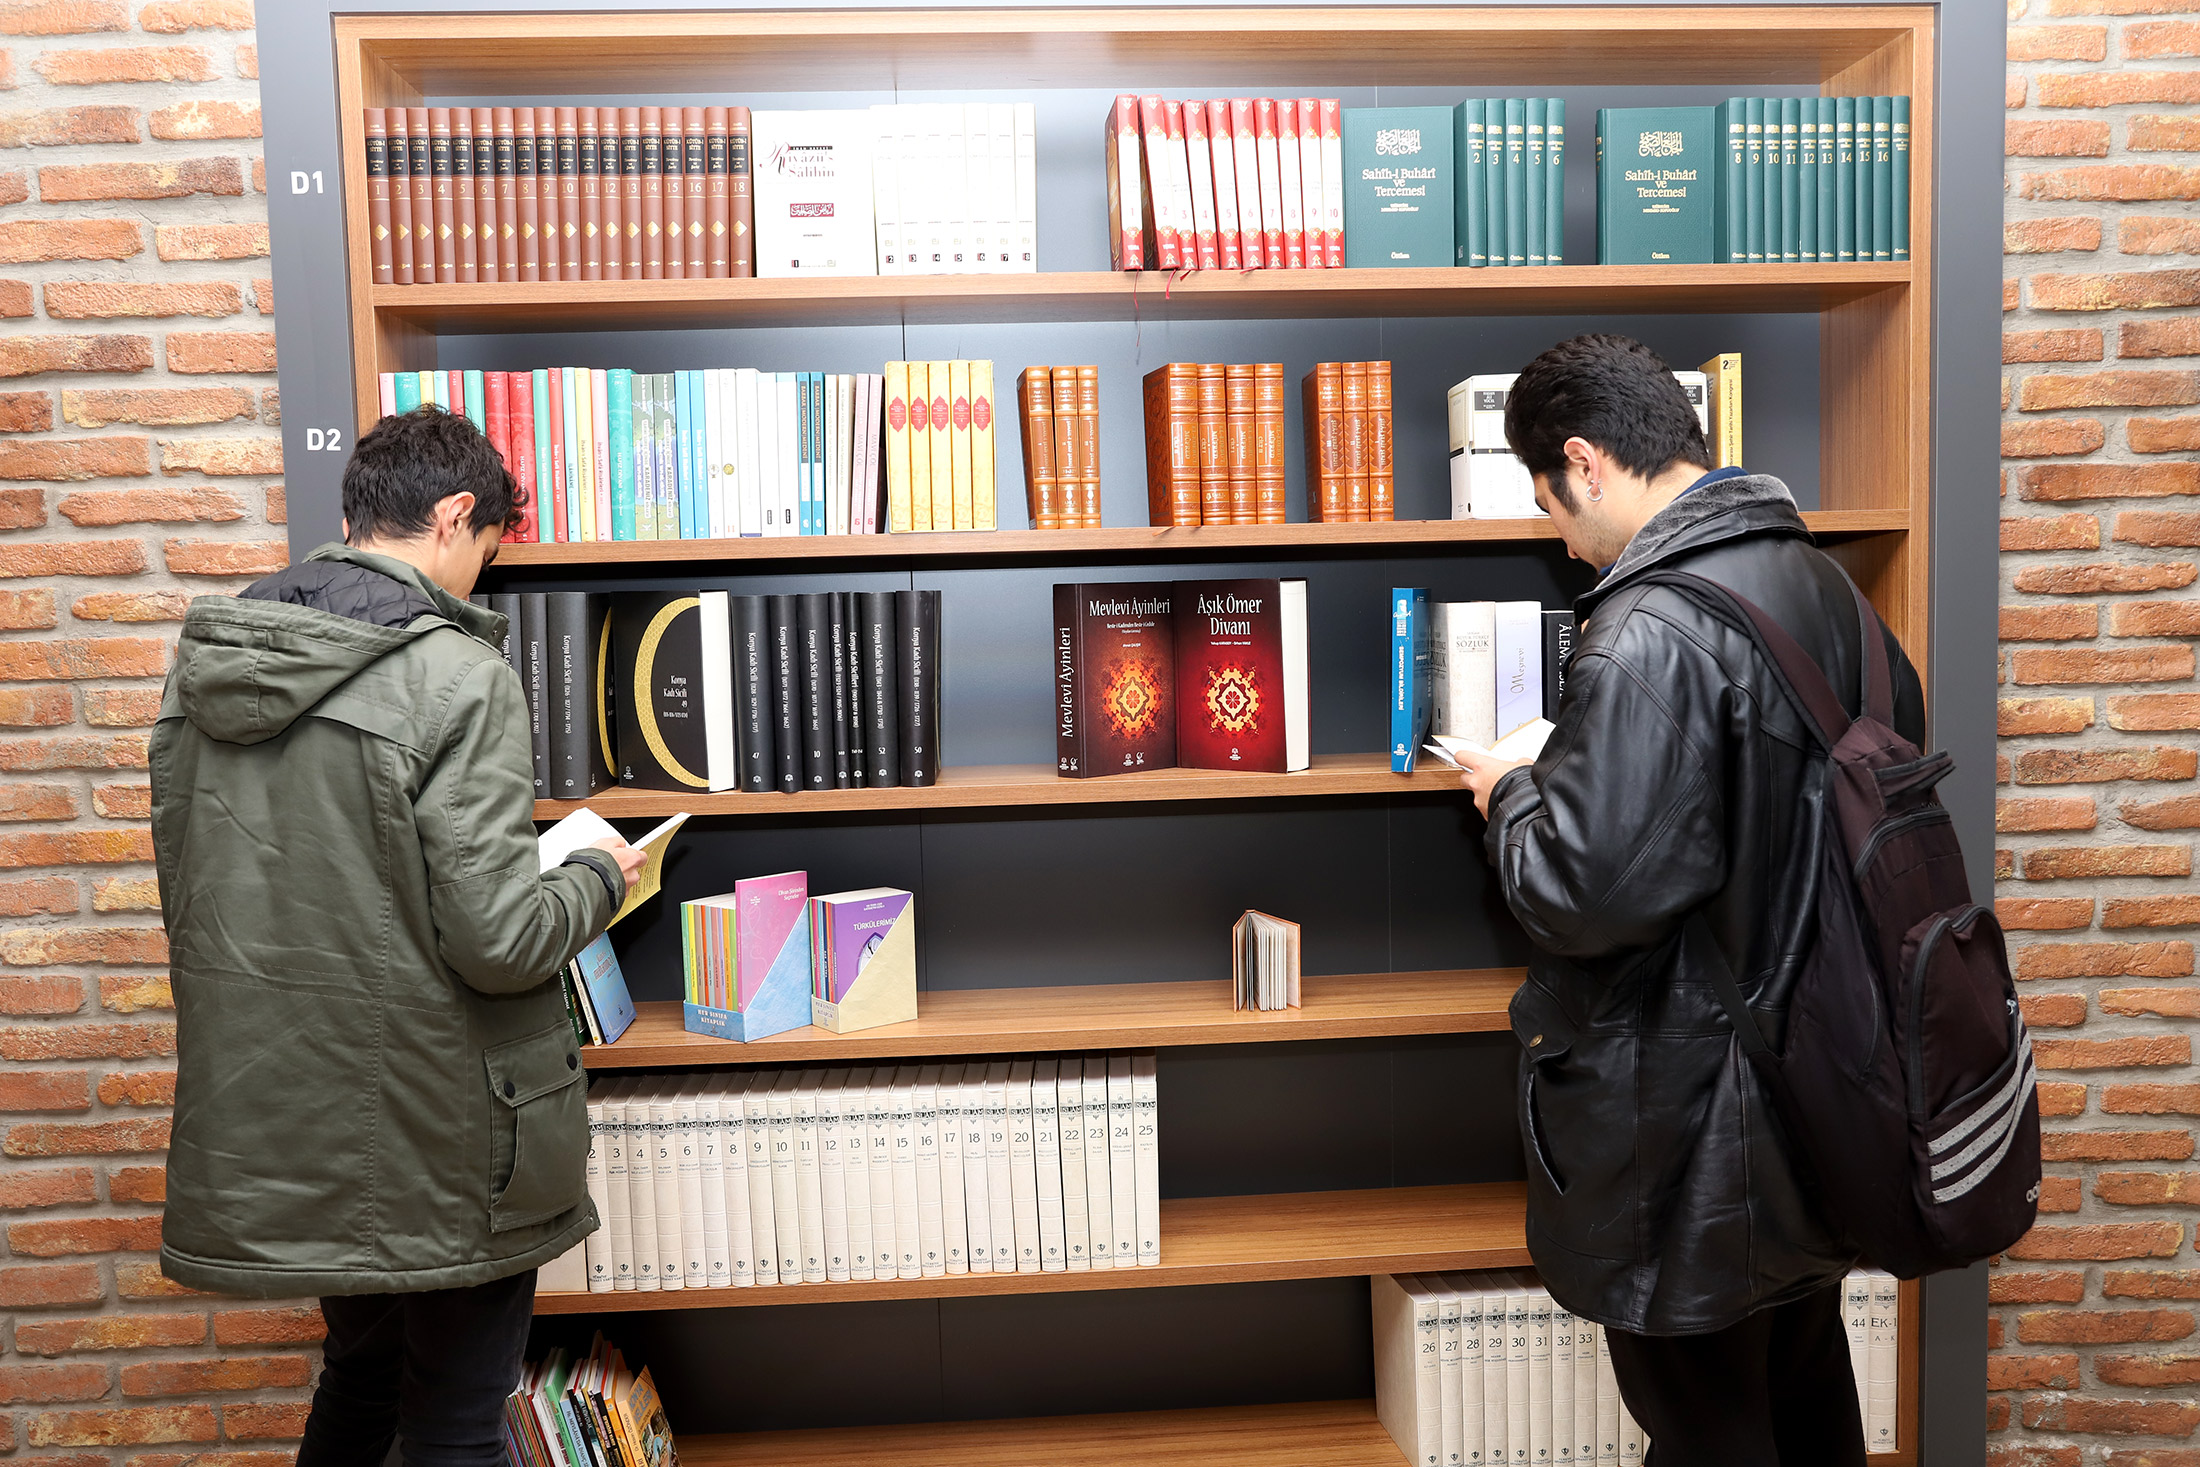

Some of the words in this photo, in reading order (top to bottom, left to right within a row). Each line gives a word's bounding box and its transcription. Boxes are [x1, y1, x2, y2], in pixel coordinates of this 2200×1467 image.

[1473, 153, 1480, 163] 2
[1493, 154, 1499, 164] 3
[1513, 154, 1520, 164] 4
[1534, 154, 1540, 164] 5
[1553, 154, 1560, 165] 6
[1734, 153, 1741, 164] 8
[1753, 154, 1759, 164] 9
[1768, 153, 1779, 163] 10
[1786, 154, 1796, 164] 11
[1804, 153, 1815, 164] 12
[1822, 153, 1833, 163] 13
[1841, 152, 1852, 163] 14
[1859, 152, 1870, 162] 15
[1877, 152, 1888, 162] 16
[1400, 167, 1436, 178] Buhârî
[1662, 169, 1697, 180] Buhârî
[291, 171, 324, 194] D1
[562, 182, 574, 193] 10
[605, 182, 616, 193] 12
[646, 182, 658, 192] 14
[667, 183, 679, 192] 15
[690, 182, 701, 192] 16
[712, 182, 724, 192] 17
[734, 182, 745, 192] 18
[1655, 180, 1667, 188] ve
[376, 185, 381, 194] 1
[396, 184, 402, 194] 2
[418, 184, 424, 194] 3
[438, 184, 446, 194] 4
[460, 184, 465, 193] 5
[481, 184, 487, 194] 6
[502, 184, 508, 194] 7
[523, 184, 529, 193] 8
[543, 184, 550, 193] 9
[584, 183, 594, 193] 11
[626, 183, 637, 193] 13
[1374, 185, 1425, 196] Tercemesi
[1637, 187, 1686, 197] Tercemesi
[1130, 208, 1134, 216] 1
[1162, 207, 1168, 216] 2
[1182, 210, 1187, 219] 3
[1202, 210, 1208, 219] 4
[1226, 209, 1231, 218] 5
[1248, 209, 1253, 217] 6
[1270, 209, 1275, 218] 7
[1291, 209, 1296, 218] 8
[1312, 208, 1317, 217] 9
[1329, 209, 1338, 218] 10
[1723, 360, 1729, 369] 2
[306, 428, 341, 451] D2
[1090, 599, 1130, 616] Mevlevi
[1131, 597, 1170, 618] Âyinleri
[1197, 594, 1225, 616] Âşık
[1226, 593, 1262, 613] Ömer
[1210, 617, 1250, 635] Divanı
[778, 626, 787, 645] Konya
[832, 624, 841, 643] Konya
[873, 624, 882, 643] Konya
[912, 627, 920, 646] Konya
[747, 632, 756, 651] Konya
[808, 630, 816, 648] Konya
[848, 632, 857, 650] Konya
[562, 635, 571, 654] Konya
[1059, 627, 1074, 682] Âyinleri
[671, 675, 686, 686] Konya
[682, 700, 688, 708] 49
[1061, 684, 1073, 737] Mevlevi
[853, 917, 897, 931] TÜRKÜLERİMİZ
[701, 1017, 725, 1026] KİTAPLIK
[1064, 1130, 1079, 1140] 22
[1089, 1128, 1104, 1139] 23
[1114, 1127, 1128, 1138] 24
[1138, 1125, 1153, 1136] 25
[921, 1136, 932, 1146] 16
[944, 1132, 956, 1143] 17
[969, 1133, 980, 1143] 18
[991, 1132, 1002, 1143] 19
[1014, 1132, 1029, 1143] 20
[1040, 1132, 1053, 1142] 21
[754, 1142, 761, 1152] 9
[776, 1142, 787, 1152] 10
[801, 1140, 811, 1151] 11
[825, 1140, 836, 1150] 12
[850, 1138, 861, 1149] 13
[874, 1137, 885, 1148] 14
[896, 1138, 908, 1148] 15
[589, 1149, 596, 1158] 2
[613, 1148, 620, 1158] 3
[636, 1148, 644, 1158] 4
[660, 1148, 667, 1158] 5
[683, 1145, 691, 1156] 6
[706, 1145, 714, 1155] 7
[730, 1144, 737, 1154] 8
[1852, 1319, 1865, 1327] 44
[1872, 1318, 1896, 1327] EK-1
[1489, 1338, 1502, 1348] 29
[1512, 1337, 1526, 1347] 30
[1535, 1336, 1548, 1346] 31
[1557, 1336, 1572, 1346] 32
[1578, 1333, 1593, 1344] 33
[1422, 1343, 1436, 1353] 26
[1445, 1341, 1458, 1351] 27
[1466, 1339, 1480, 1349] 28
